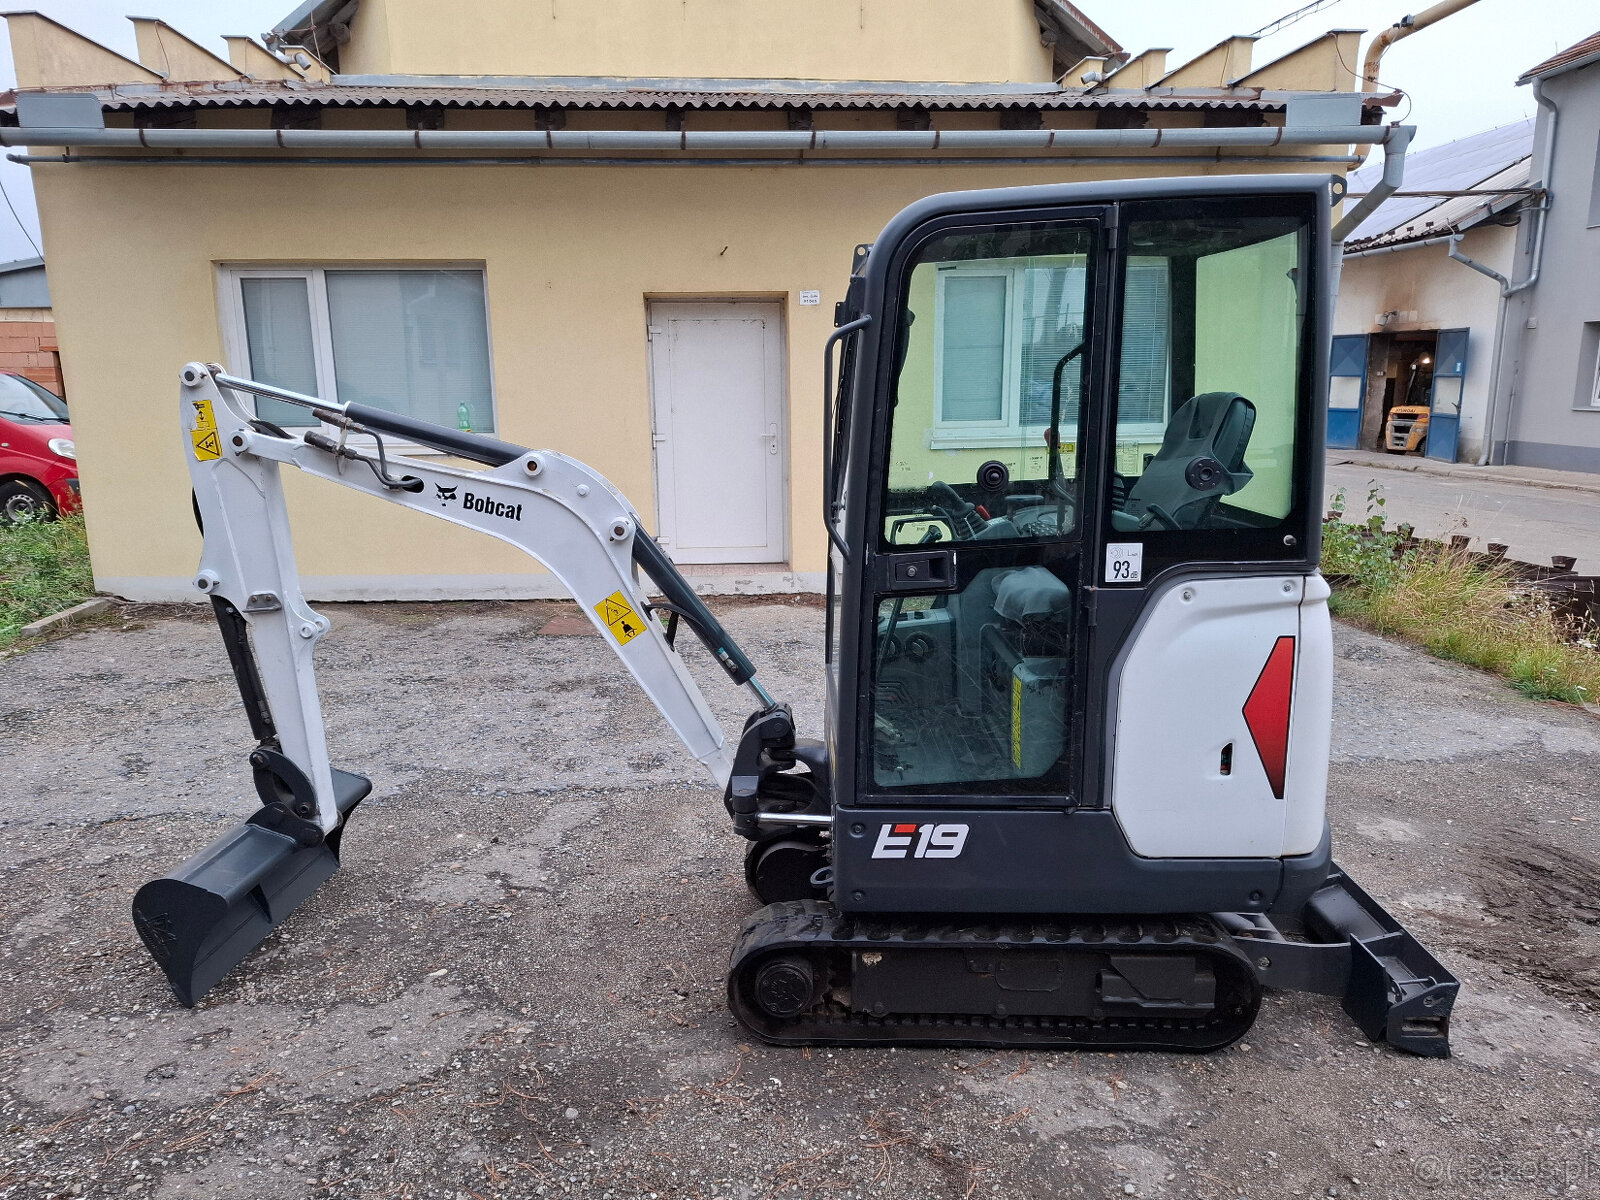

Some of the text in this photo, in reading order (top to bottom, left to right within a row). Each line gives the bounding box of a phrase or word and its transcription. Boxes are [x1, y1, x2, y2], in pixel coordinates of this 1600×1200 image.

[463, 493, 522, 522] Bobcat
[1113, 560, 1131, 579] 93
[871, 824, 970, 859] E19
